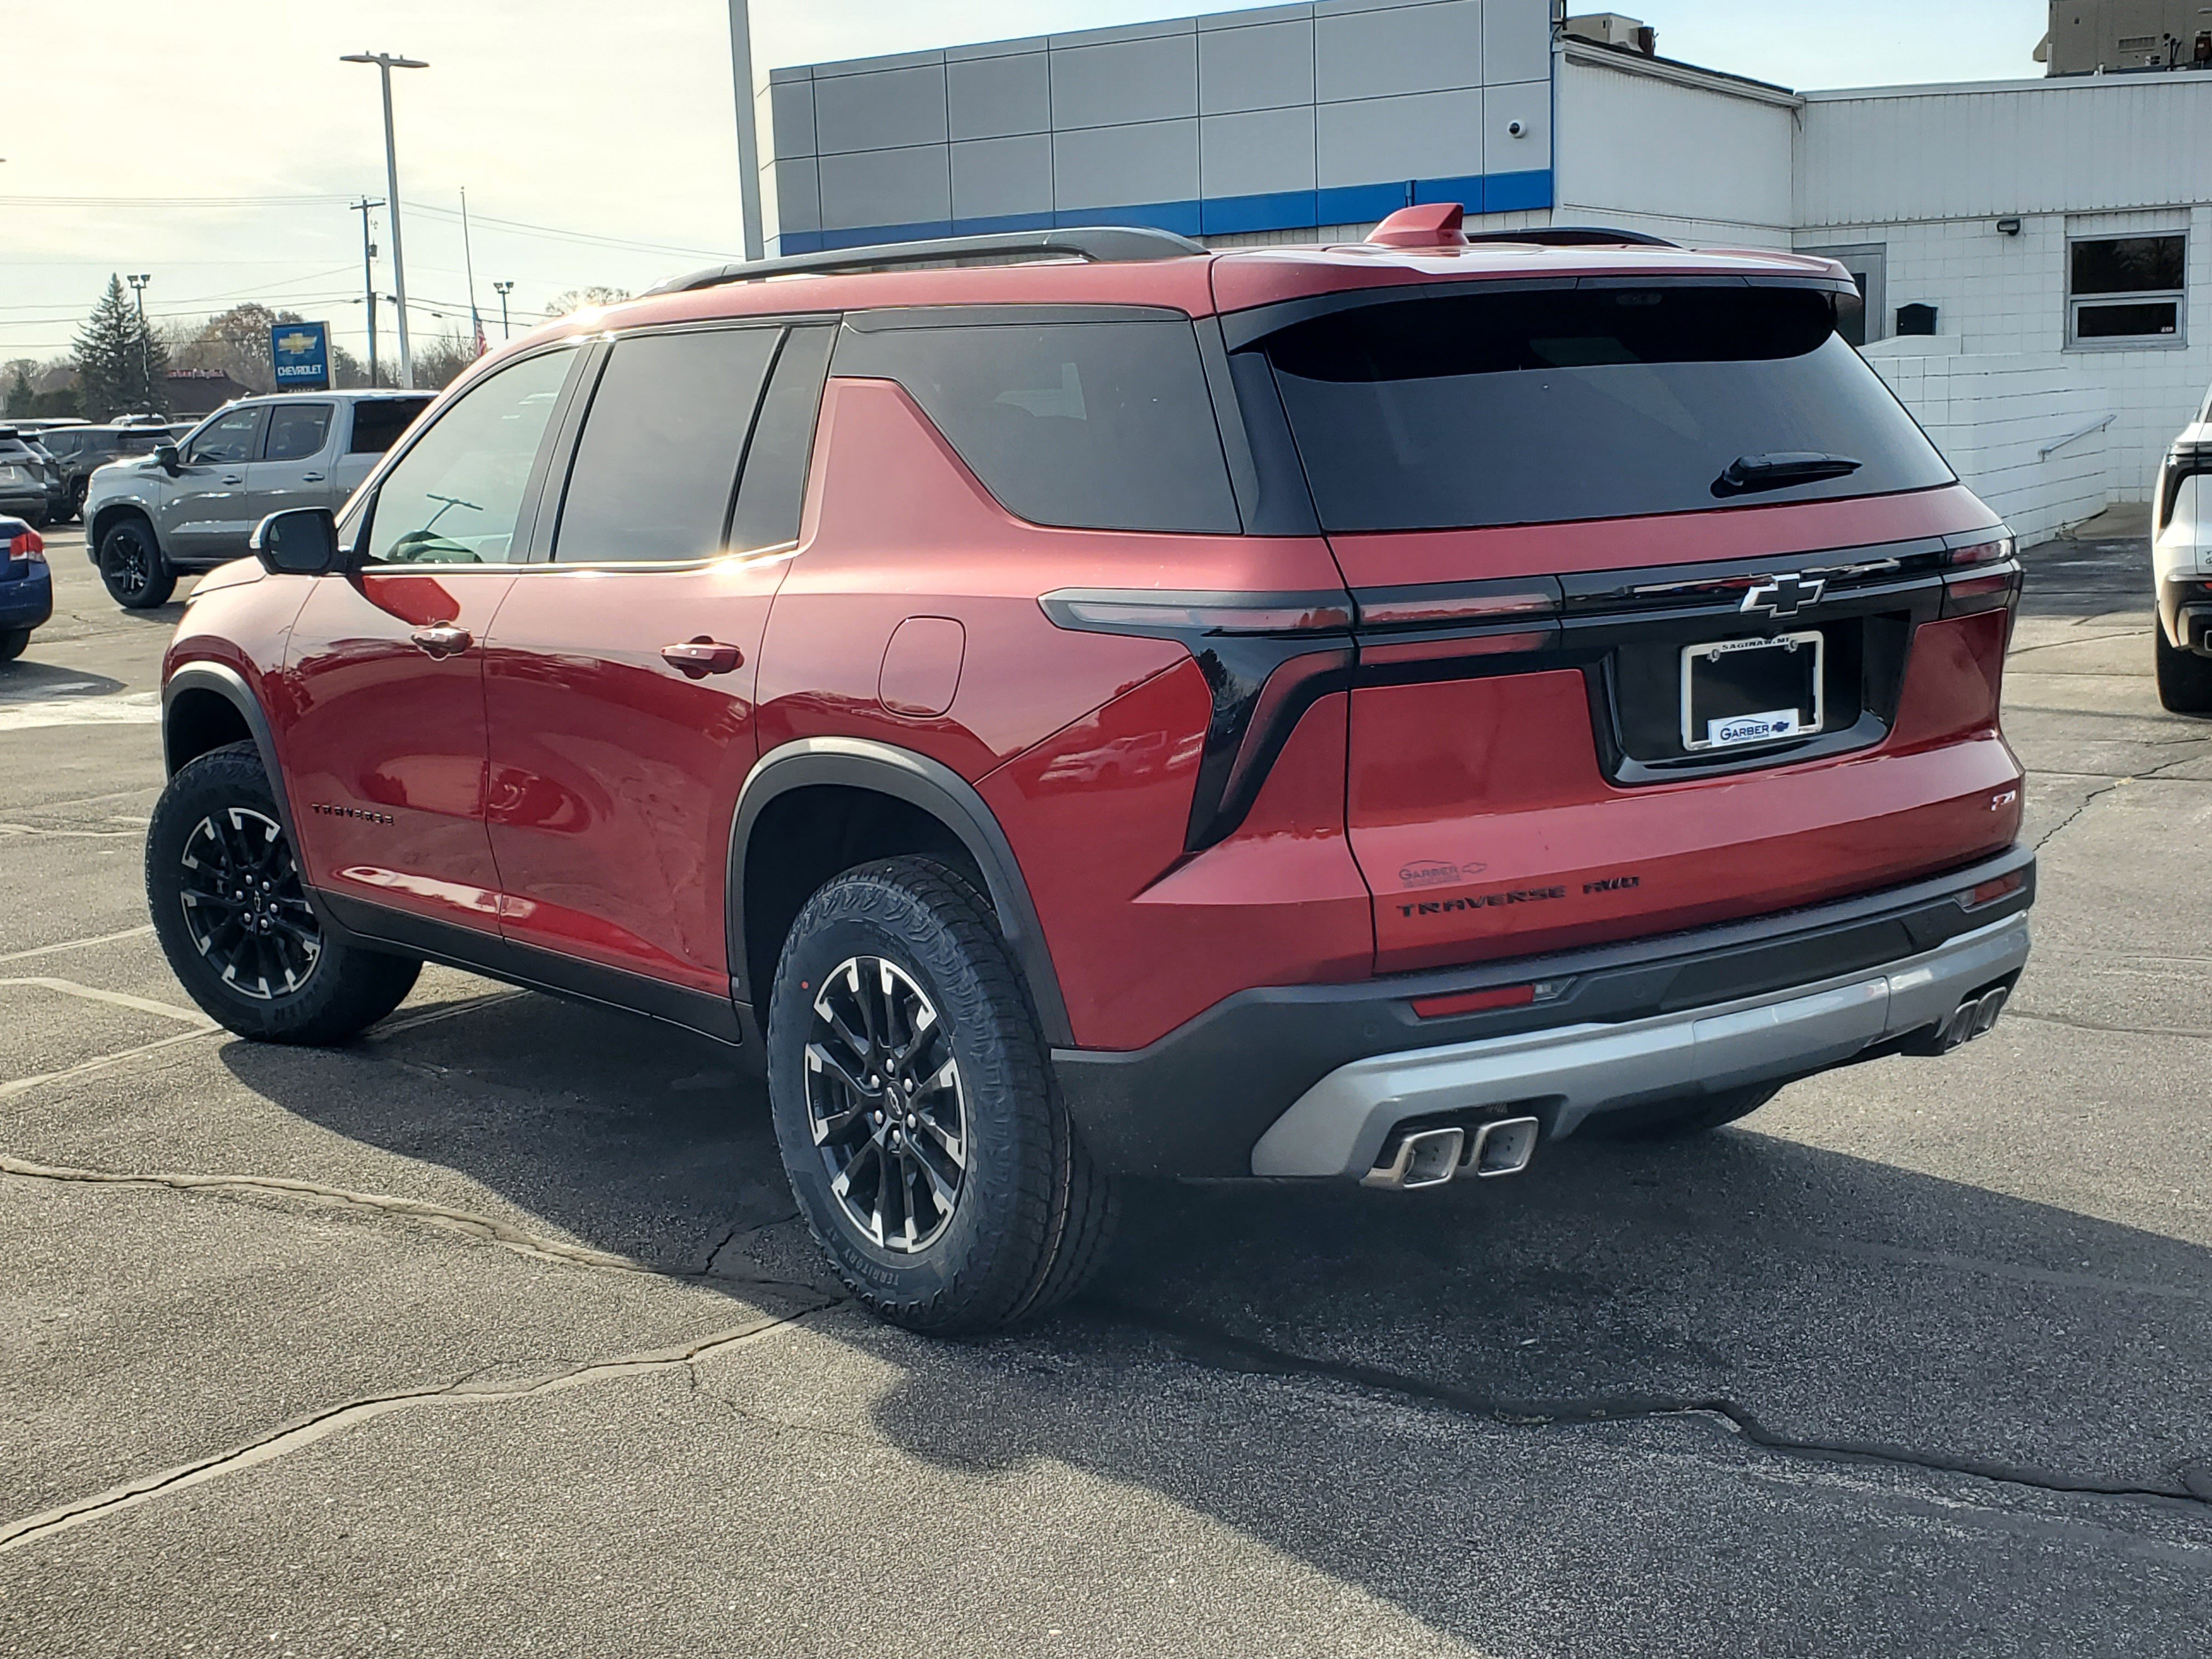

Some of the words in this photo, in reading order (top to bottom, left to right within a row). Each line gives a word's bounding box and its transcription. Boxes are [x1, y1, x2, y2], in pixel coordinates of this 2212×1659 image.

[278, 364, 322, 376] CHEVROLET
[1720, 725, 1769, 740] GARBER
[312, 803, 394, 826] TRAVERSE
[1399, 866, 1458, 880] GARBER
[1396, 885, 1566, 917] TRAVERSE
[1582, 876, 1640, 894] AWD
[843, 1248, 899, 1286] TERRITORY
